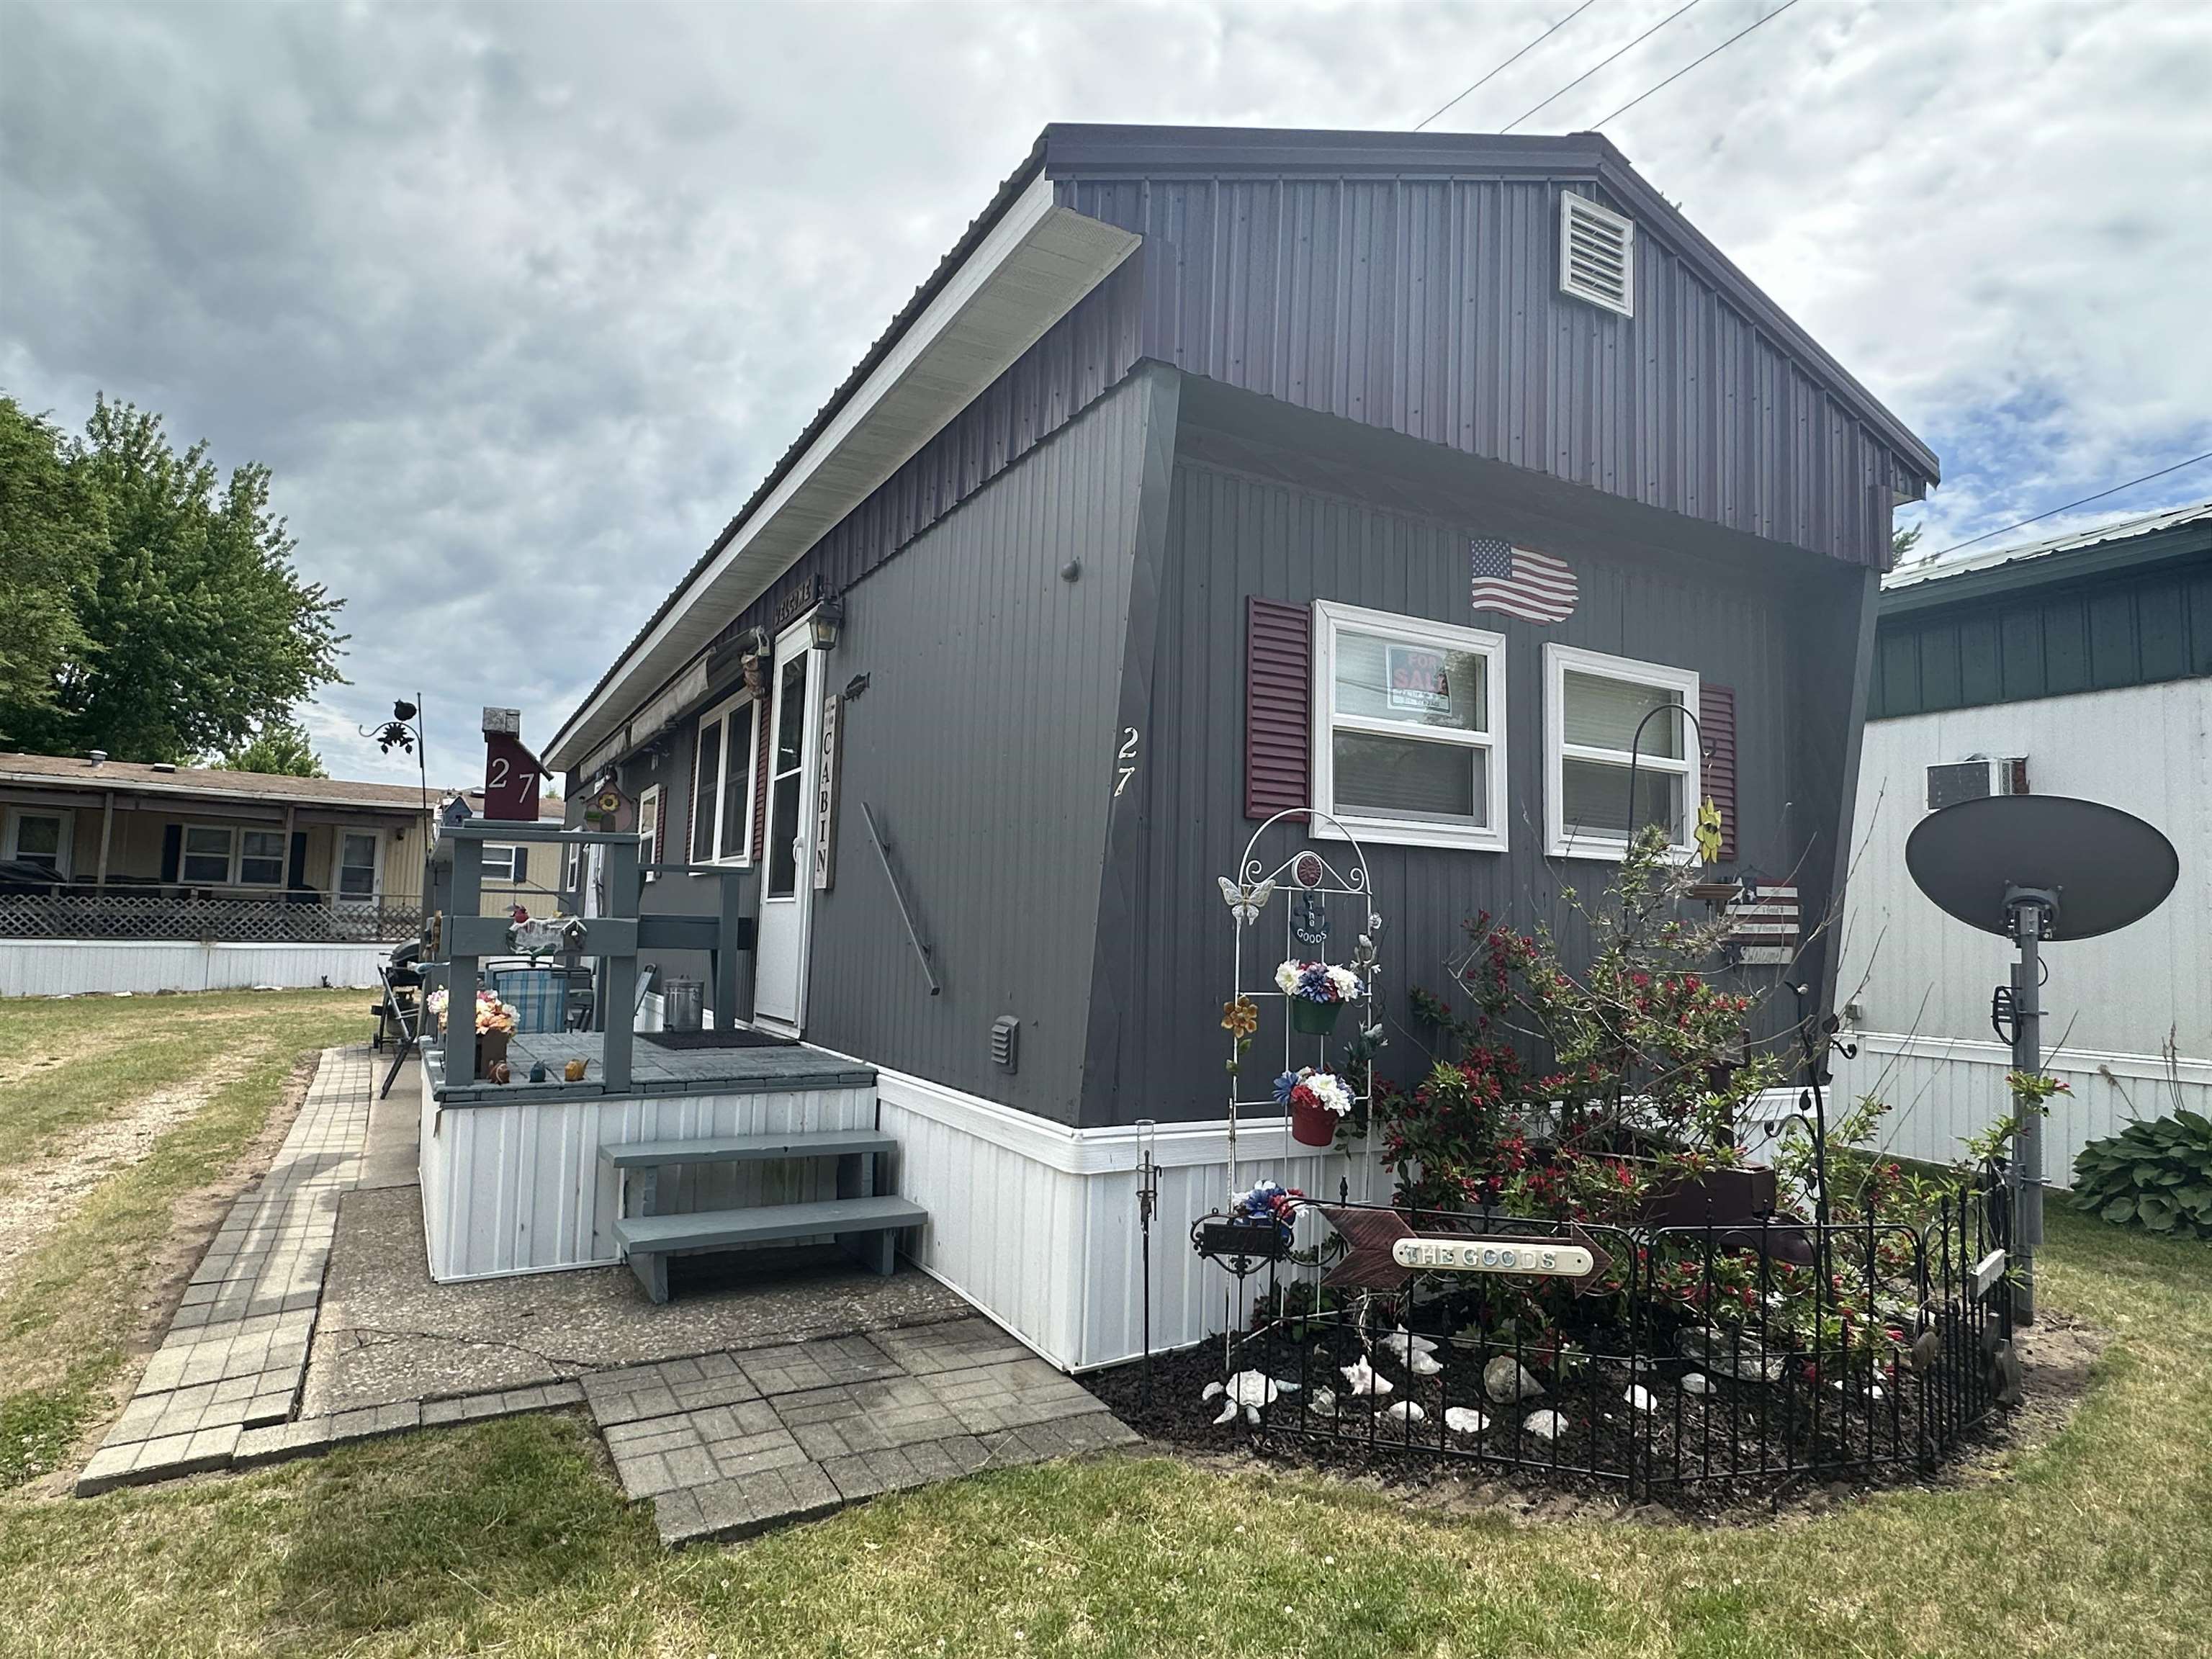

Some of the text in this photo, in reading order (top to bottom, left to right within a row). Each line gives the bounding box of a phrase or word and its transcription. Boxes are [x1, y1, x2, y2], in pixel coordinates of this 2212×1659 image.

[1407, 652, 1437, 669] FOR
[1114, 727, 1138, 797] 27
[488, 757, 535, 804] 27
[817, 732, 832, 873] CABIN
[1297, 928, 1327, 944] GOODS
[1404, 1244, 1557, 1270] THE GOODS
